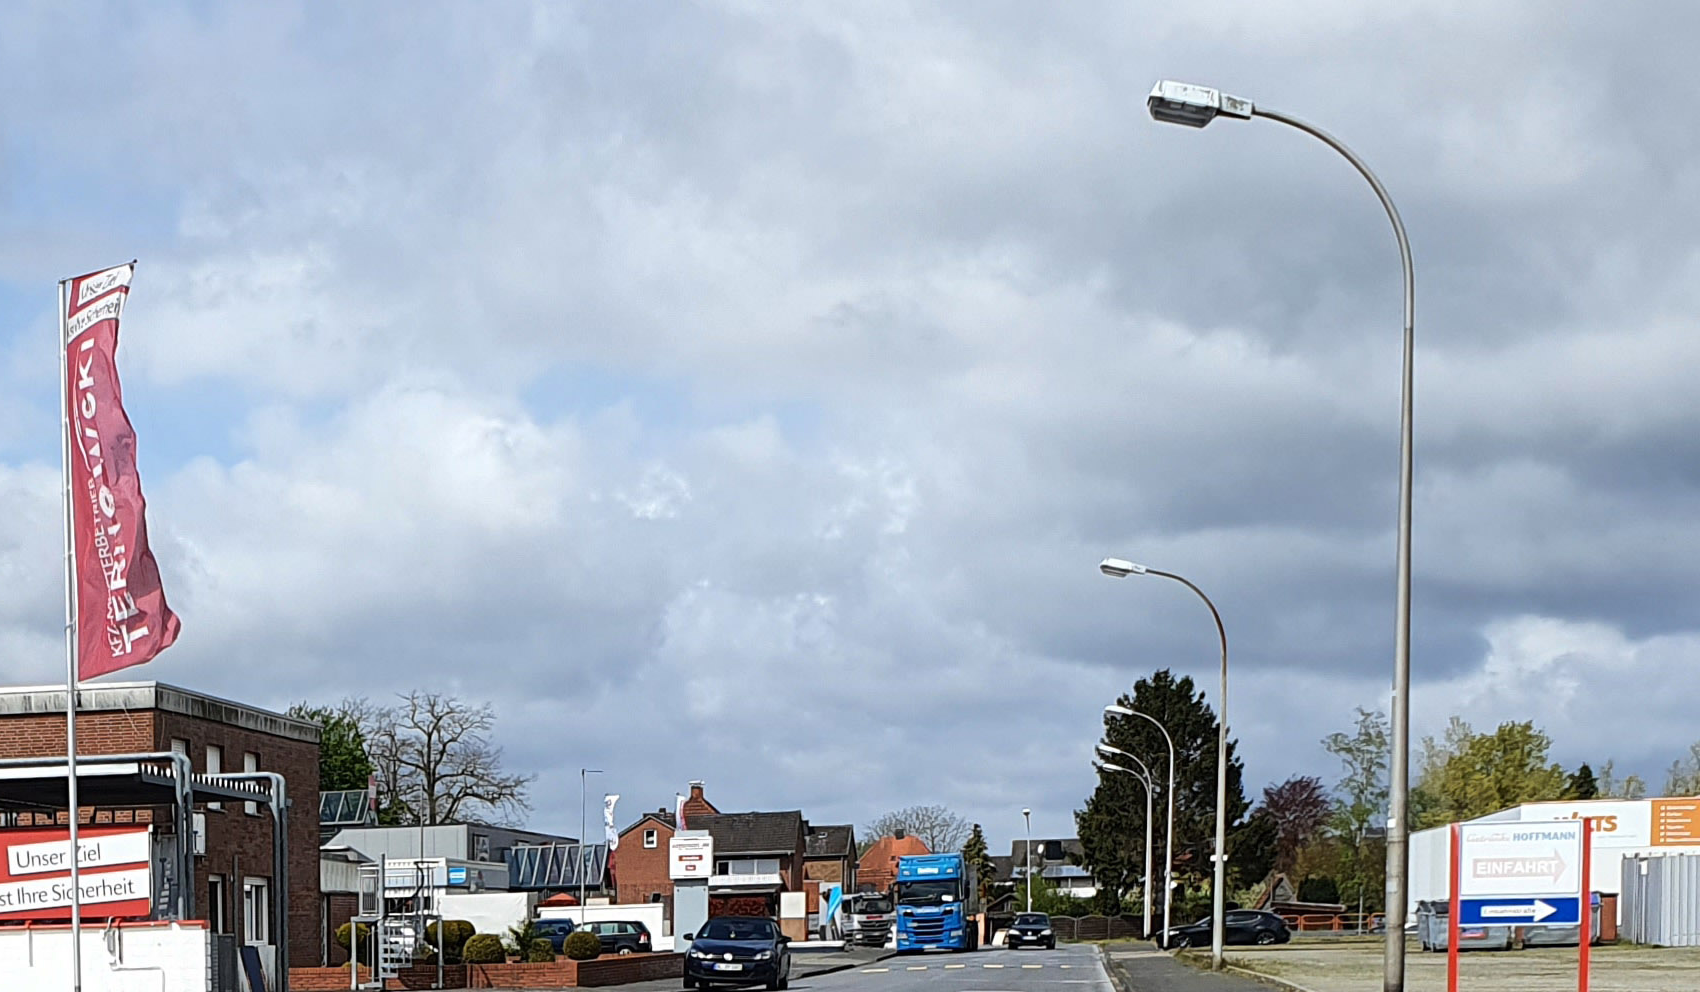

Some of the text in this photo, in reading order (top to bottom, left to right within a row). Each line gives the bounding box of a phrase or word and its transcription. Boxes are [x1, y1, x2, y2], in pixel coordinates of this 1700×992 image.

[1512, 831, 1576, 842] HOFFMANN
[16, 842, 101, 869] Unser Ziel
[1476, 860, 1559, 875] EINFAHRT
[17, 887, 48, 905] Ihre
